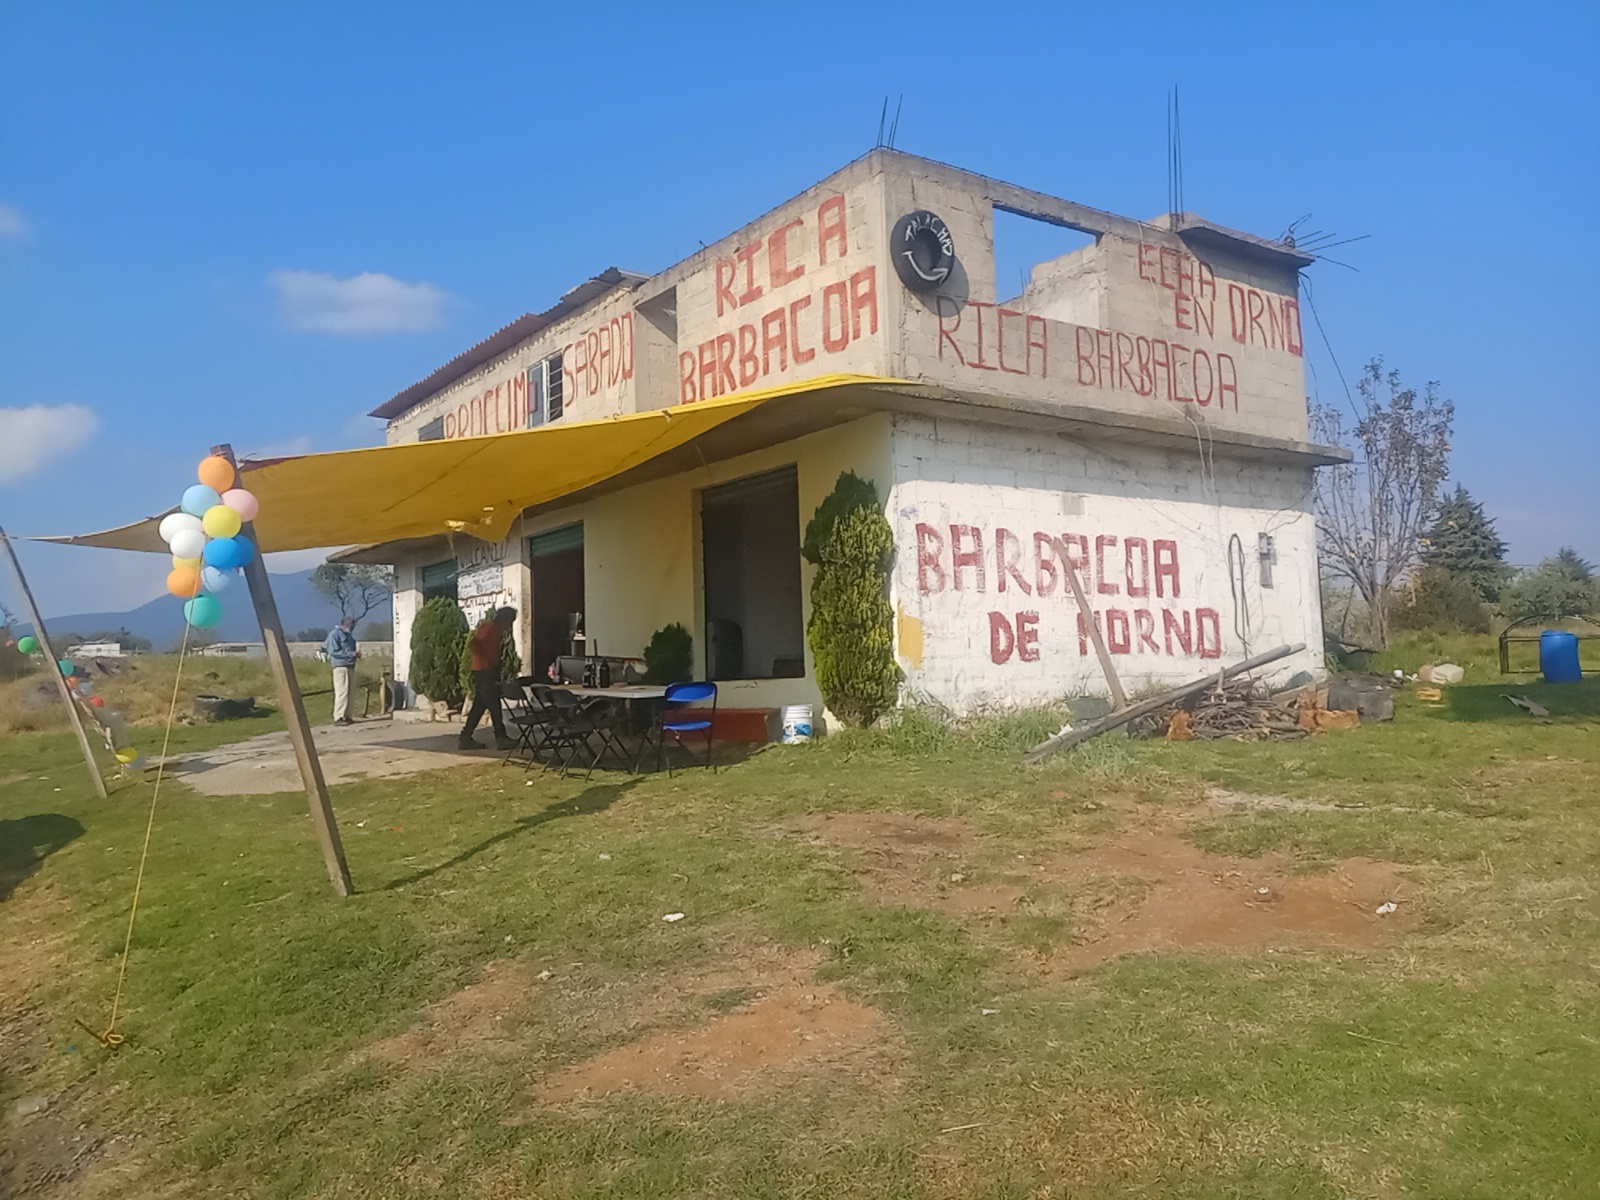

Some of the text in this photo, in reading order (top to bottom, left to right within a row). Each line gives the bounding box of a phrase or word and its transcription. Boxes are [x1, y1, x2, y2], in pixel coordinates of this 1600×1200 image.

[715, 193, 848, 318] RICA
[1138, 243, 1217, 301] ECHA
[562, 311, 635, 408] SABADO
[678, 265, 878, 405] BARBACOA
[936, 295, 1048, 379] RICA
[1174, 283, 1304, 358] EN ORNO
[1075, 325, 1239, 413] BARBACOA
[915, 522, 1181, 599] BARBACOA
[987, 610, 1041, 665] DE
